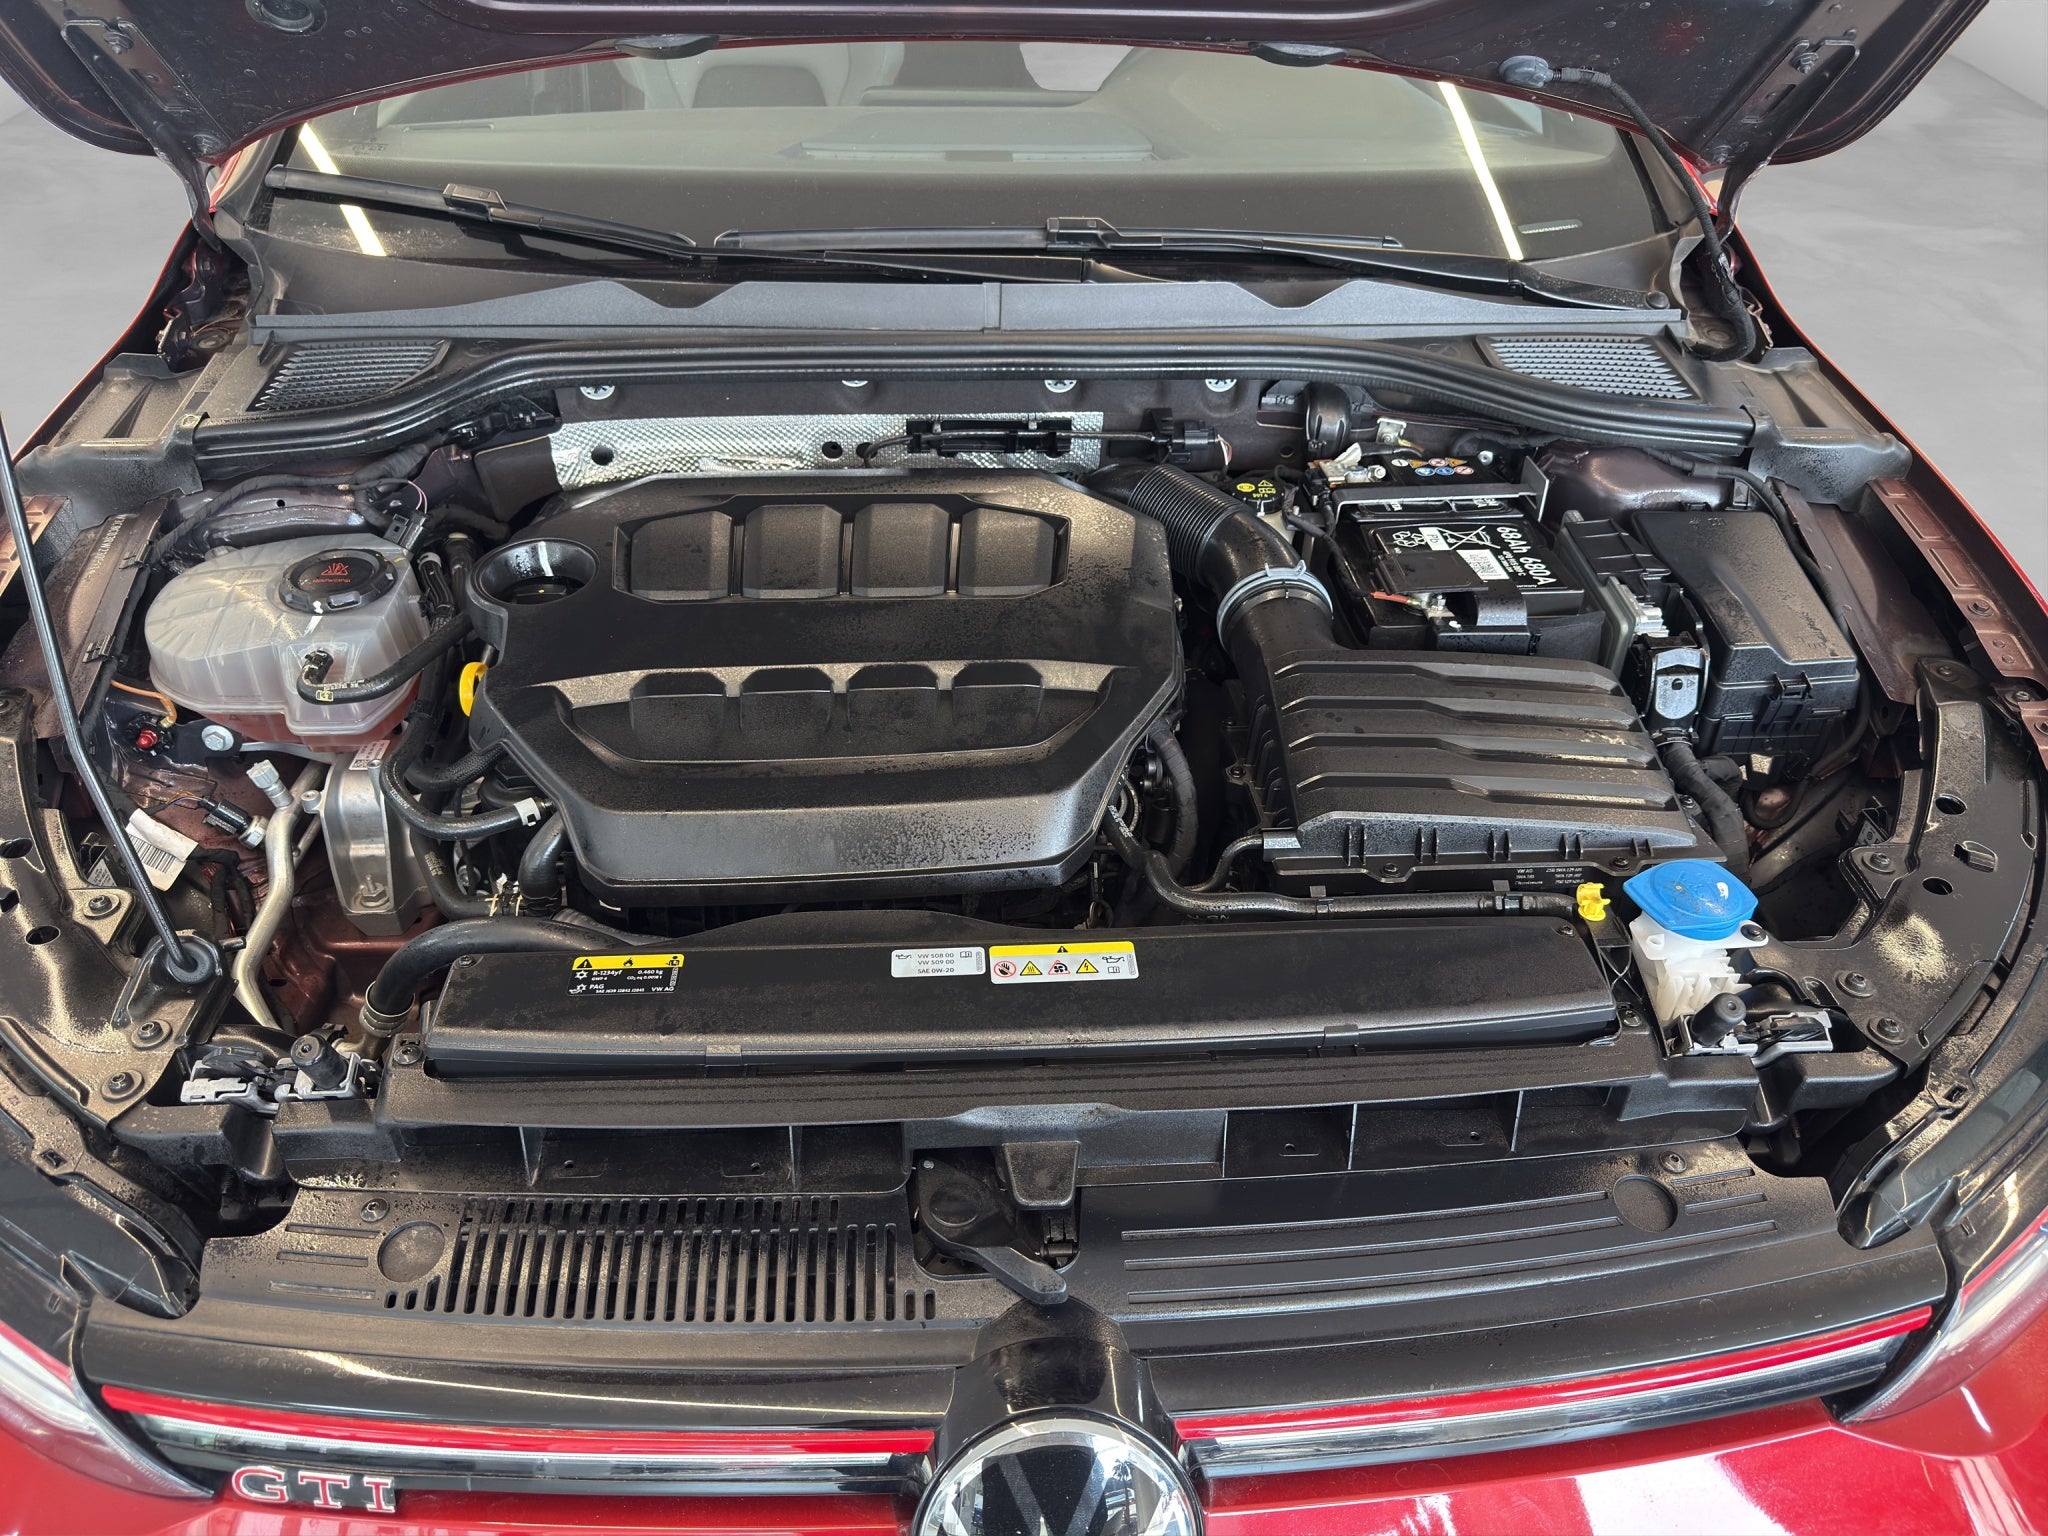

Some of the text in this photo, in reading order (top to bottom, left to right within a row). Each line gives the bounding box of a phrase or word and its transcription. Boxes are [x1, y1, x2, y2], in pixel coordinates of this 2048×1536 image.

[1426, 533, 1439, 544] Pb
[1496, 526, 1532, 554] 68Ah
[1519, 557, 1558, 586] 680A
[592, 969, 623, 977] R-1234yf
[232, 1464, 396, 1514] GTI
